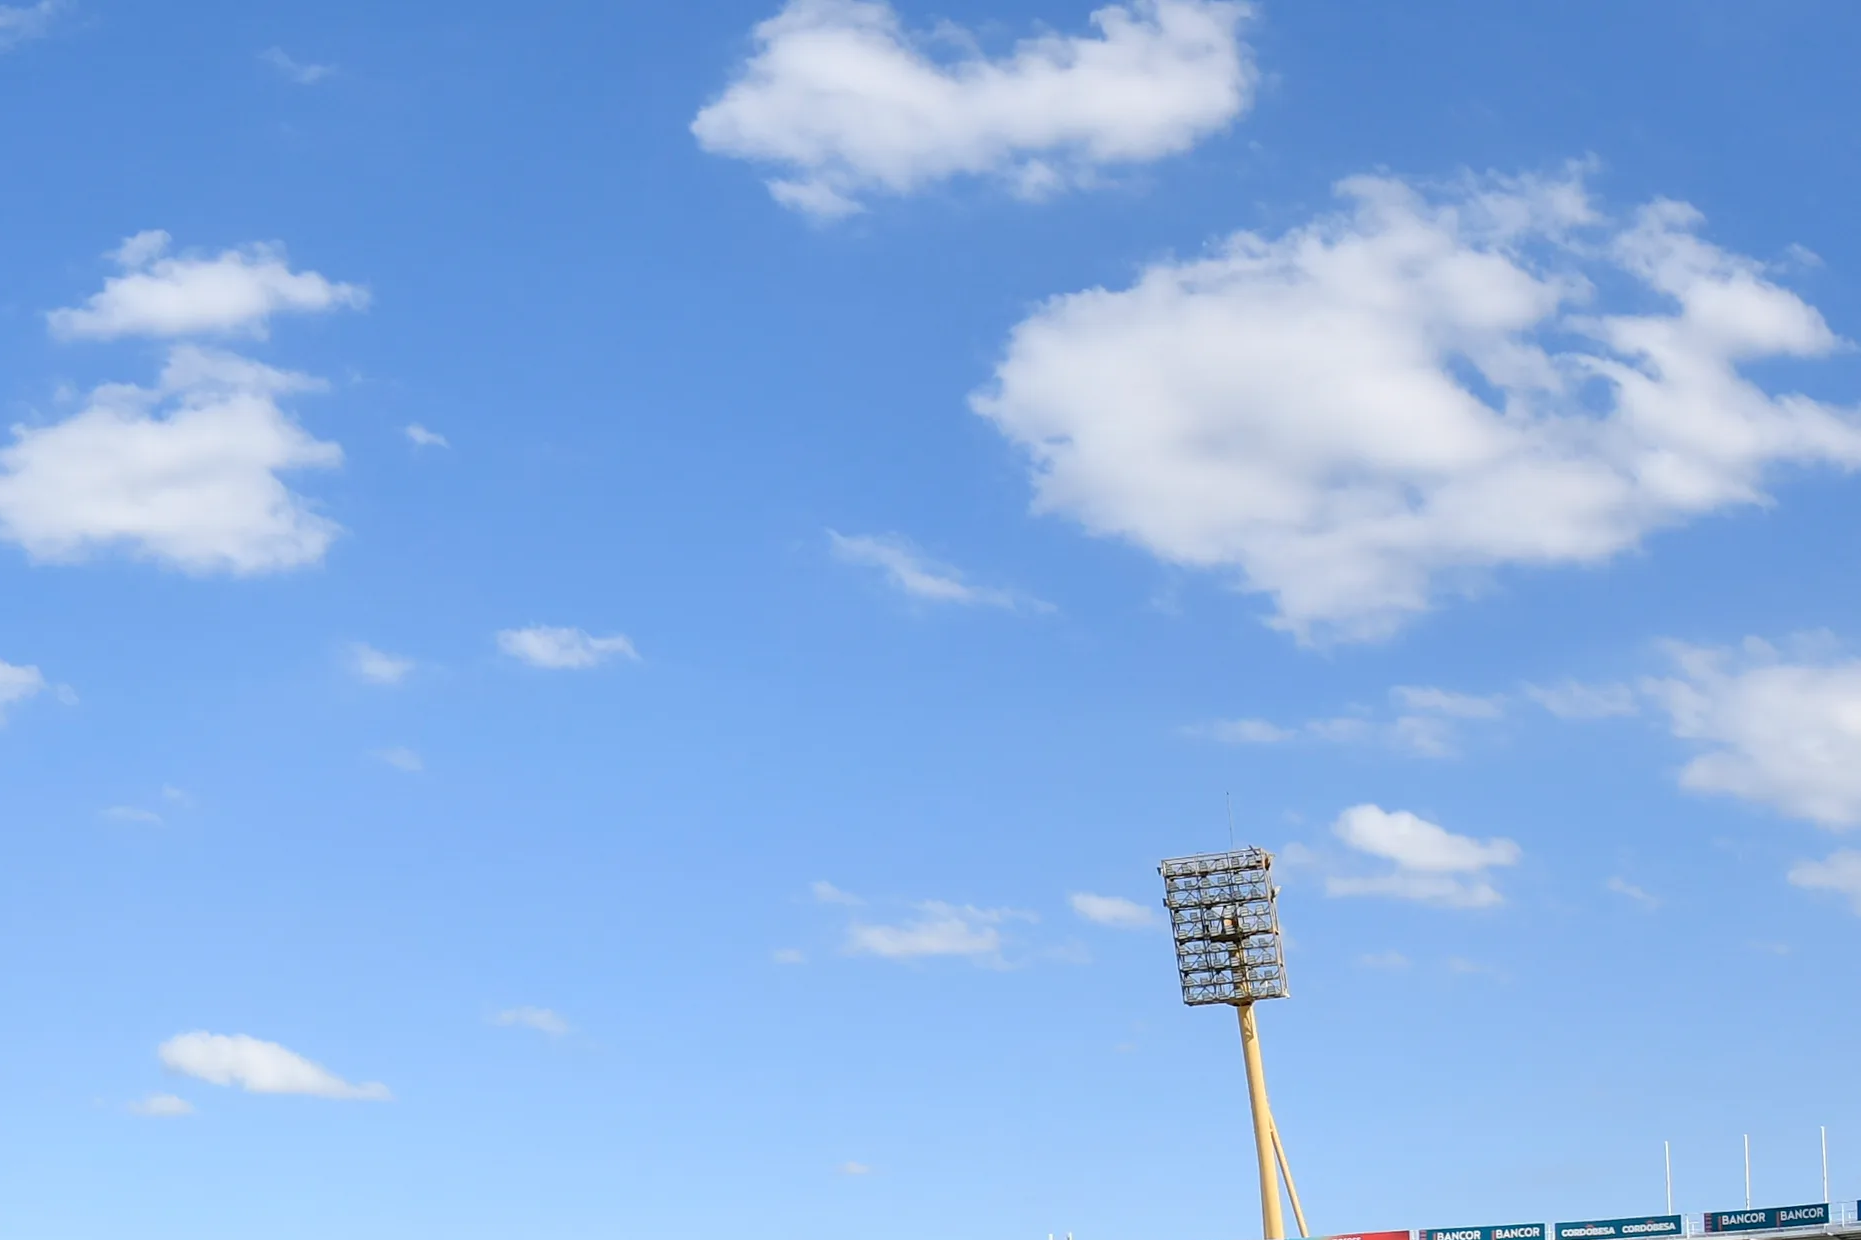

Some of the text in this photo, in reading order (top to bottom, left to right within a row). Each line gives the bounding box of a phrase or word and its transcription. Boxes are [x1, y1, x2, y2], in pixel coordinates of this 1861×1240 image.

[1721, 1213, 1766, 1225] BANCOR
[1780, 1207, 1824, 1221] BANCOR
[1496, 1227, 1540, 1240] BANCOR
